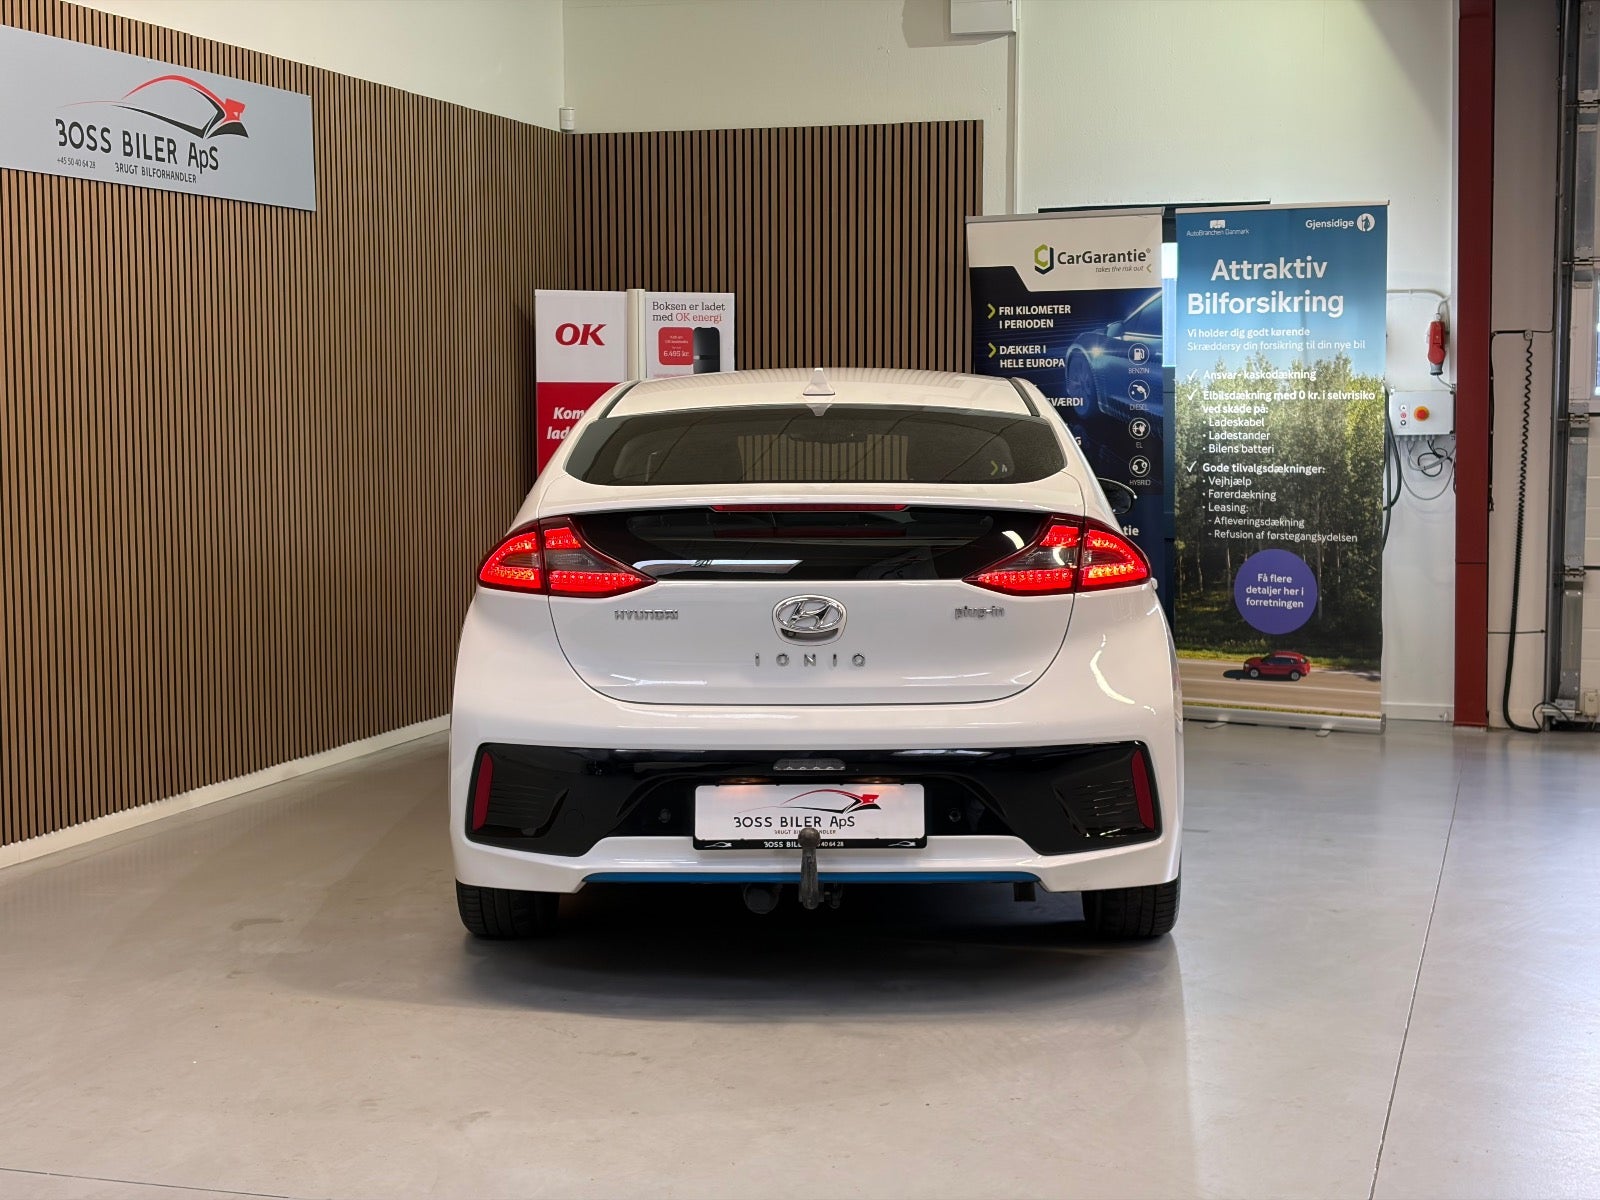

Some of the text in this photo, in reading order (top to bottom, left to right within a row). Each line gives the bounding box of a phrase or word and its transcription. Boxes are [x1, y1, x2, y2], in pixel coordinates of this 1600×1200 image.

[122, 130, 177, 165] BILER
[187, 142, 219, 174] ApS
[141, 166, 197, 184] BILFORHANDLER
[1306, 218, 1354, 229] Gjensidige
[1210, 256, 1328, 282] Attraktiv
[652, 301, 687, 311] Boksen
[701, 302, 726, 312] ladet
[1187, 290, 1344, 318] Bilforsikring
[999, 304, 1071, 316] FRI KILOMETER
[652, 313, 722, 324] med OK energi
[1000, 319, 1054, 329] I PERIODEN
[555, 323, 607, 346] OK
[1187, 328, 1310, 339] Vi holder dig godt kørende
[1000, 345, 1046, 354] DÆKKER I
[1187, 340, 1366, 352] Skræddersy din forsikring til din nye bil
[1000, 358, 1065, 368] HELE EUROPA
[1244, 370, 1316, 381] kaskodækning
[1203, 391, 1272, 402] Elbilsdækning
[1274, 391, 1296, 400] med
[1299, 391, 1306, 399] 0
[1308, 391, 1320, 400] kr.
[1327, 391, 1375, 400] selvrisiko
[1222, 405, 1251, 414] skade
[1208, 418, 1264, 427] Ladeskabel
[1208, 432, 1270, 440] Ladestander
[1208, 444, 1274, 454] Bilens batteri
[1202, 463, 1326, 475] Gode tilvalgsdækninger:
[1208, 477, 1252, 487] Vejhjælp
[1208, 490, 1277, 501] Førerdækning
[1208, 504, 1249, 514] Leasing:
[1214, 517, 1304, 528] Afleveringsdækning
[1214, 530, 1358, 543] Refusion af førstegangsydelsen
[1257, 574, 1292, 583] Få flere
[1246, 586, 1304, 596] detaljer her i
[1246, 598, 1304, 610] forretningen
[614, 609, 678, 620] HYUNDAI
[955, 605, 1004, 620] plug-in
[780, 816, 822, 828] BILER
[830, 816, 855, 829] ApS
